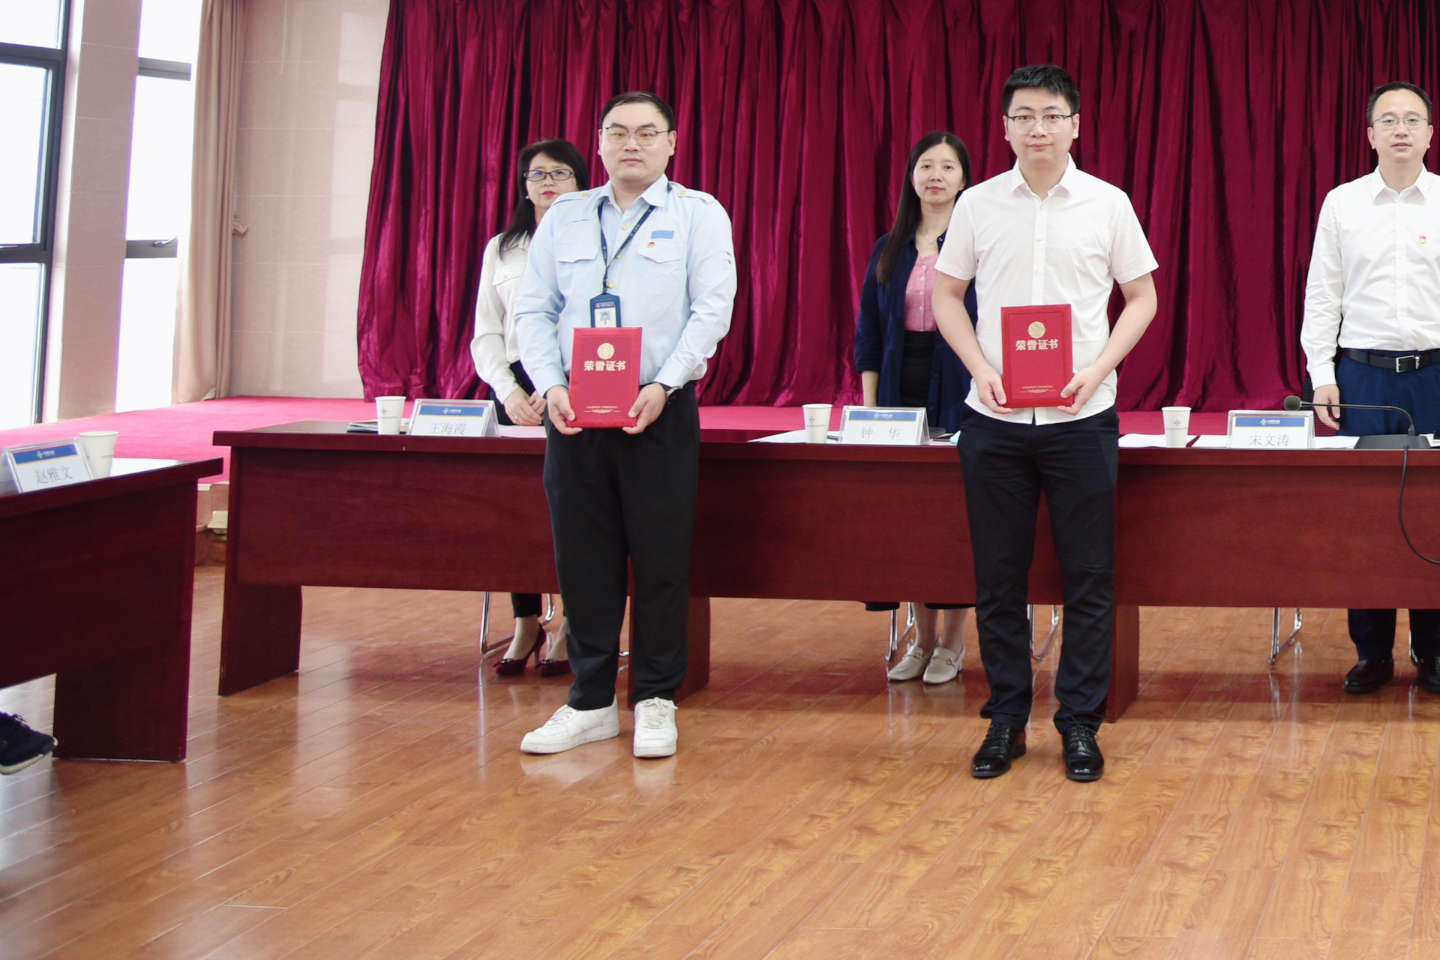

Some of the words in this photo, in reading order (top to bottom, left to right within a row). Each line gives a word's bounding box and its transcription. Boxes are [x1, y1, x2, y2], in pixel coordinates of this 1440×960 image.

[1015, 339, 1059, 352] 荣誉证书
[583, 360, 627, 373] 荣誉证书
